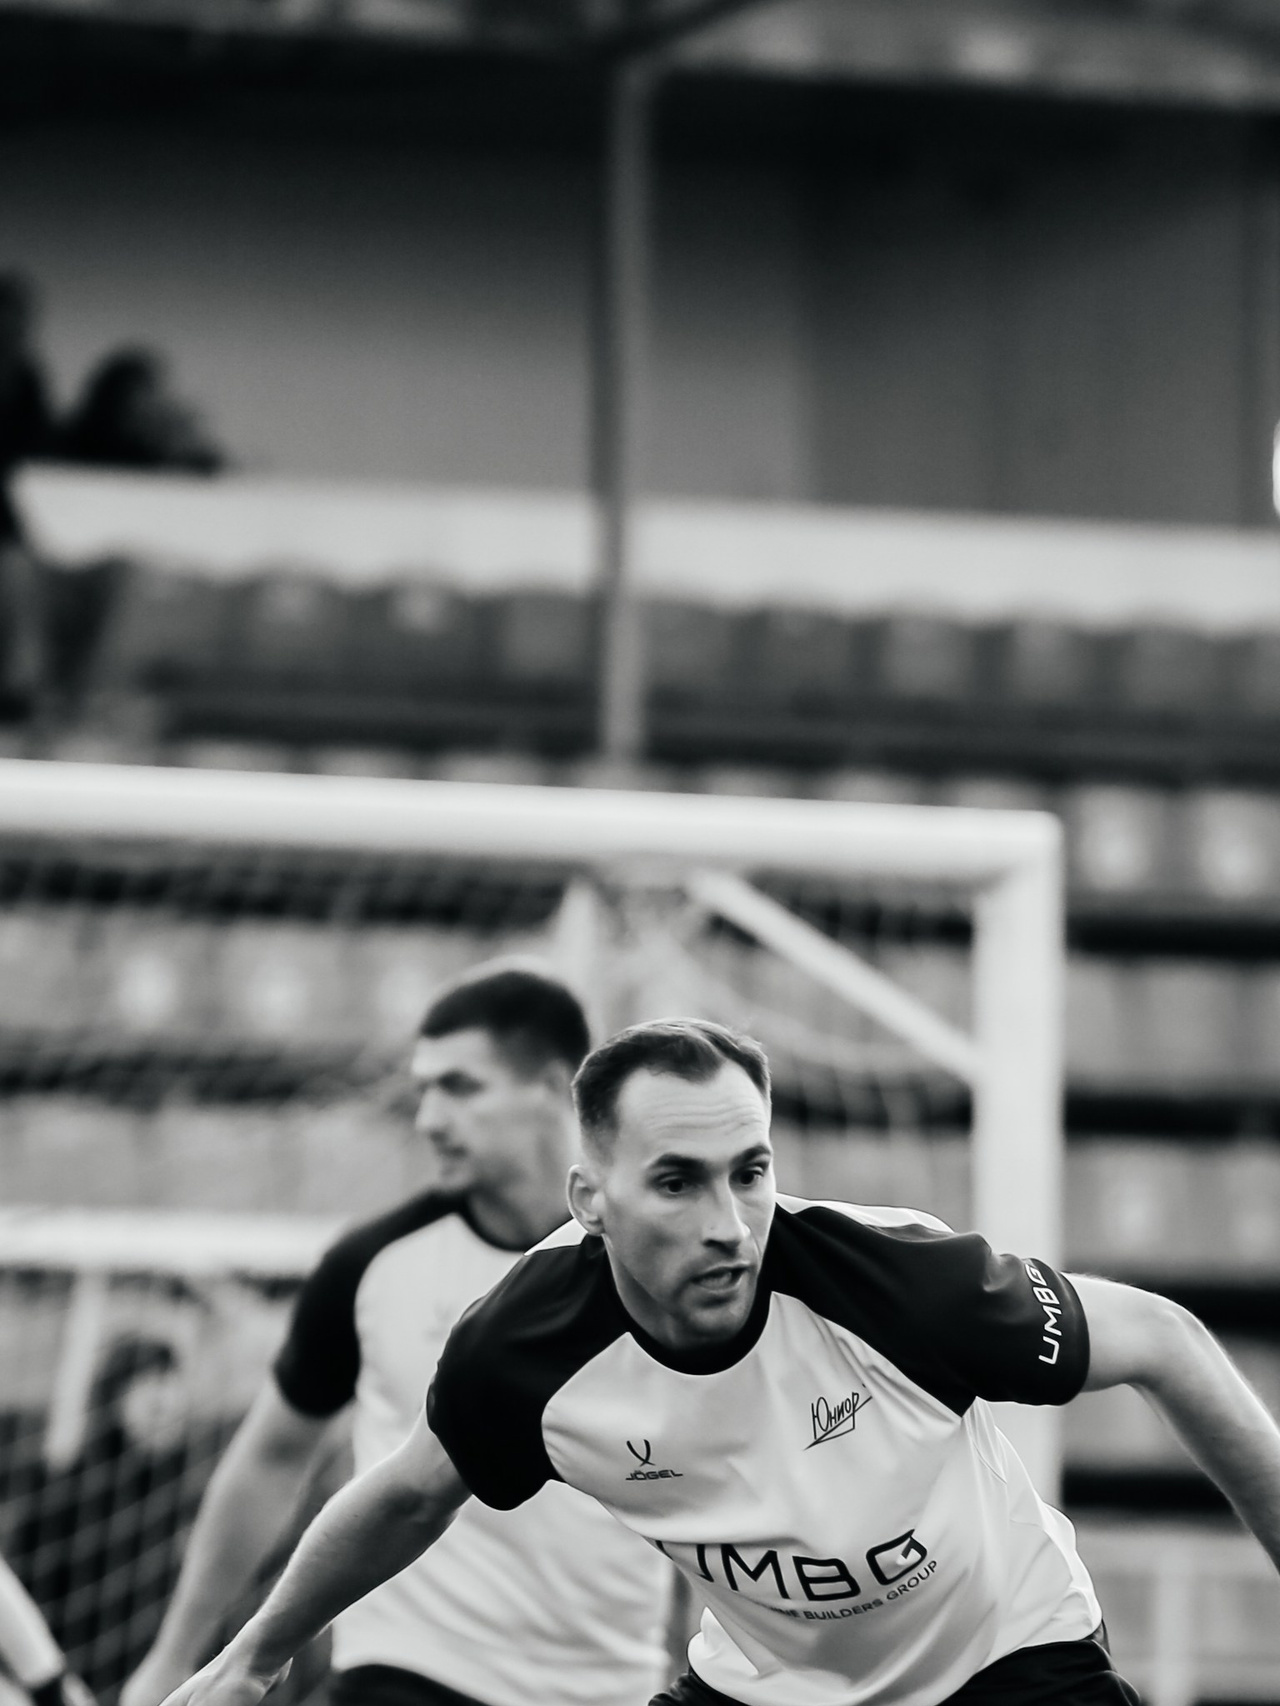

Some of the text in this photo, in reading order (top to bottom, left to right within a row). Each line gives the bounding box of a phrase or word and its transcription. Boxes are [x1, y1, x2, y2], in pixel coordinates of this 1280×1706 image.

[1024, 1263, 1062, 1365] UMBG
[803, 1598, 884, 1620] BUILDERS
[886, 1560, 938, 1601] GROUP
